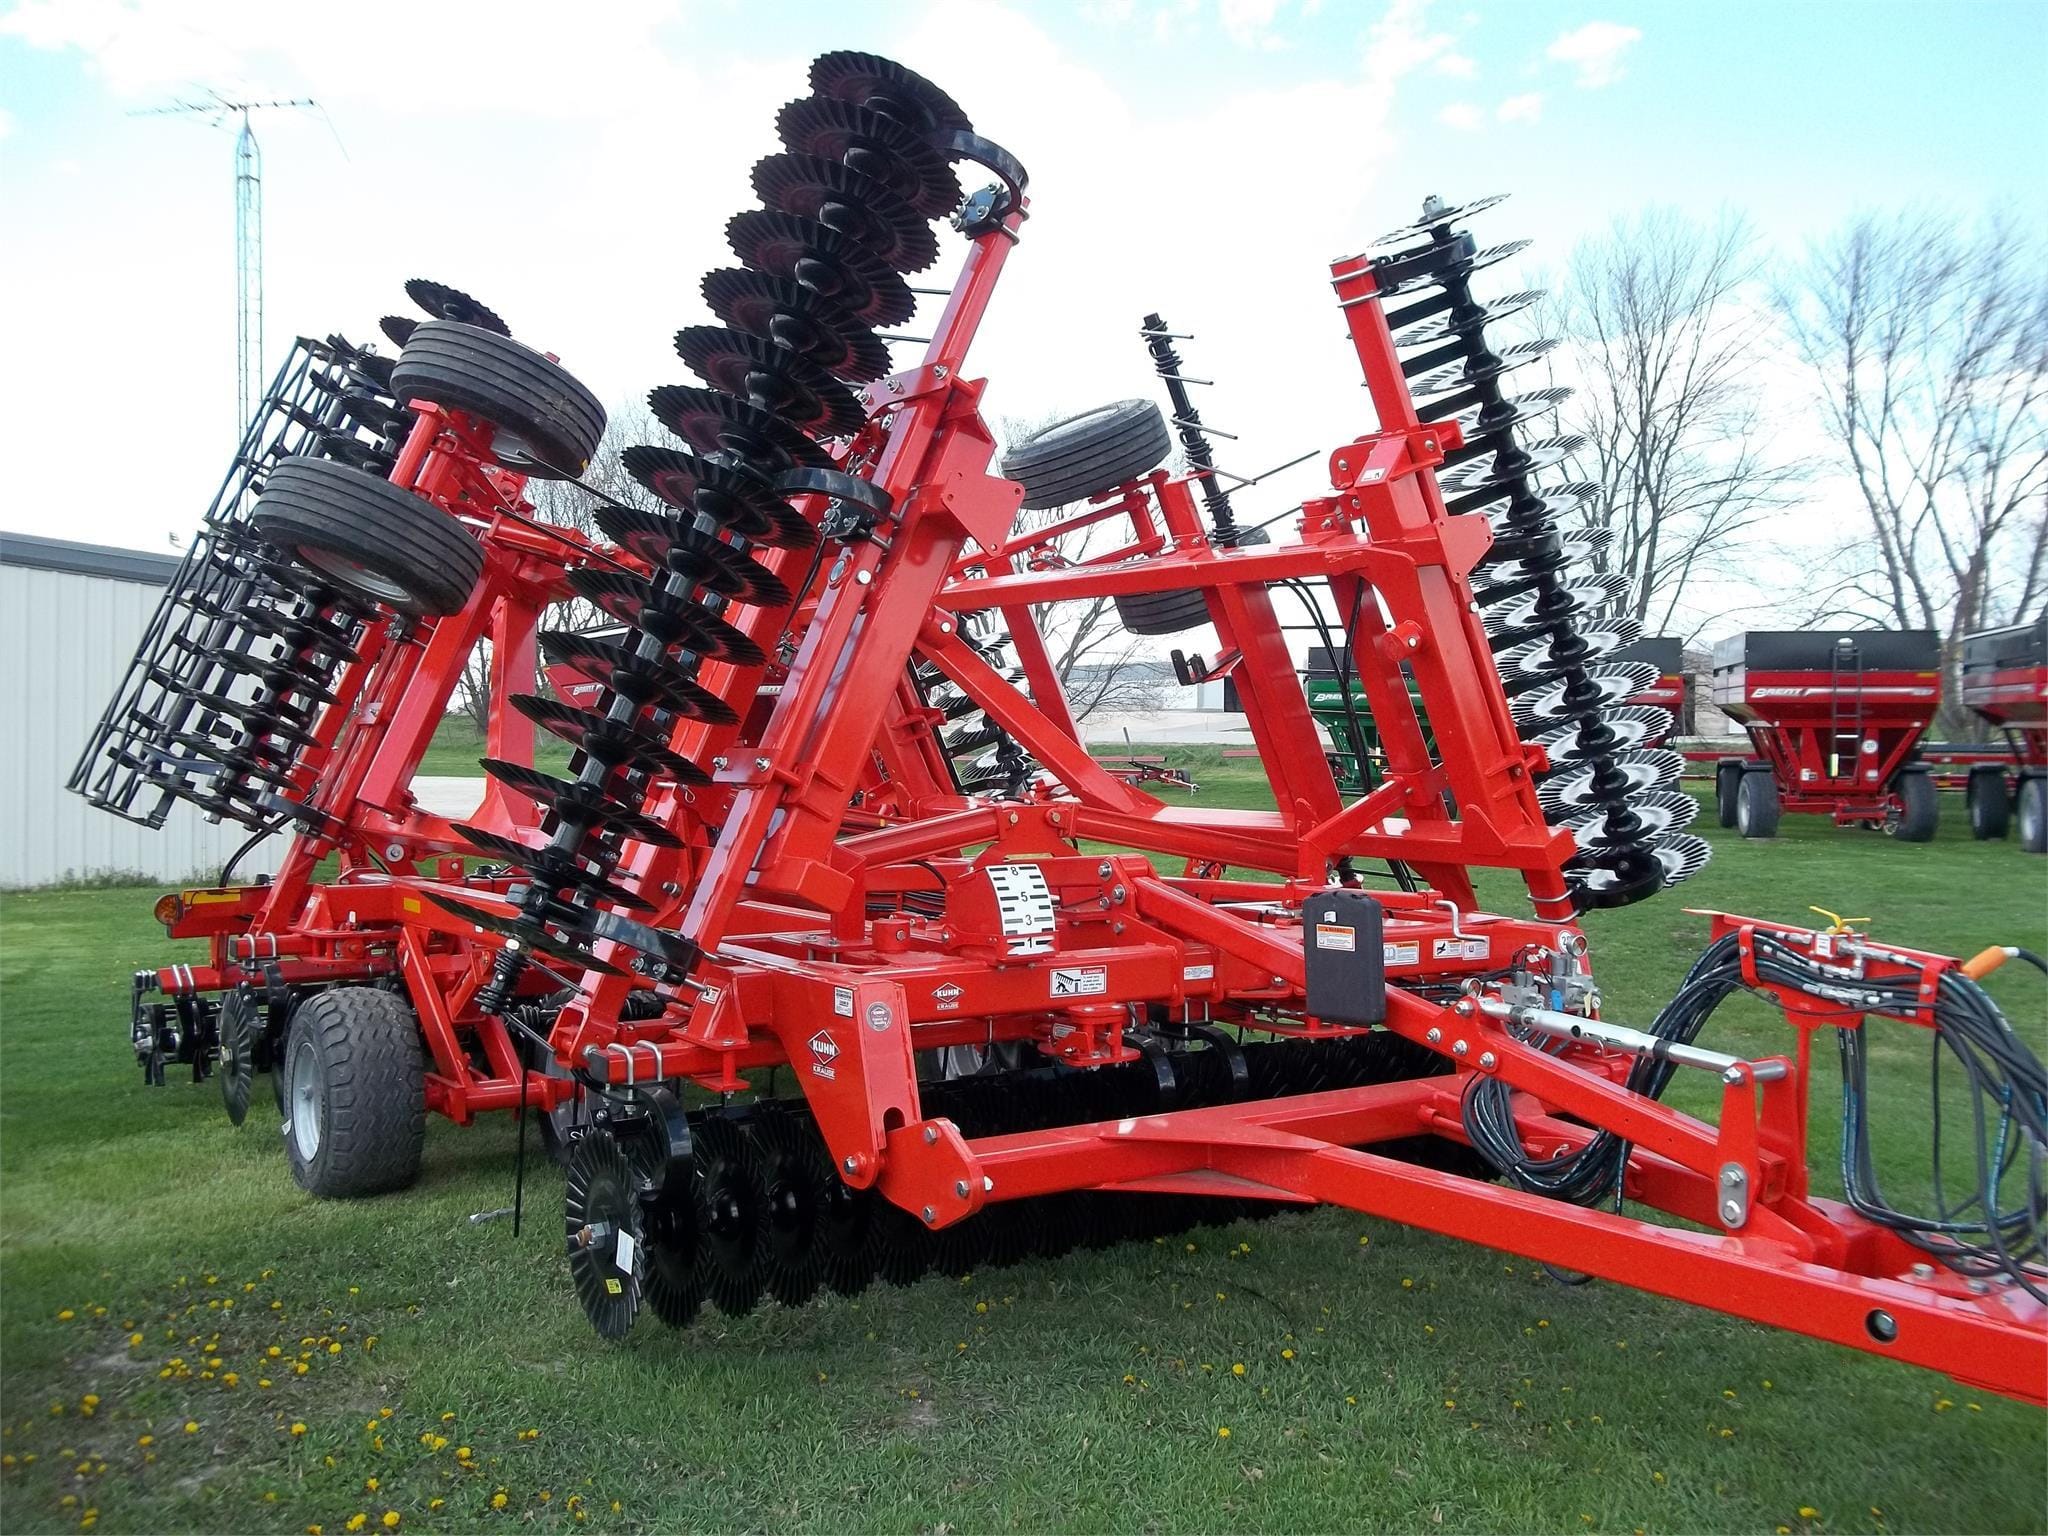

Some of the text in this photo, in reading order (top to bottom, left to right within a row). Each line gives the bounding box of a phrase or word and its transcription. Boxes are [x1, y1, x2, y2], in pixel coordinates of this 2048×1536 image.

[1314, 693, 1355, 702] BRE
[1751, 688, 1803, 698] BRENT
[1010, 866, 1019, 876] 8
[1020, 891, 1028, 902] 5
[1025, 914, 1032, 926] 3
[1027, 936, 1033, 949] 1
[936, 988, 960, 998] KUHN
[936, 1002, 959, 1010] KRAUSE
[812, 1039, 836, 1057] KUHN
[812, 1065, 836, 1078] KRAUSE
